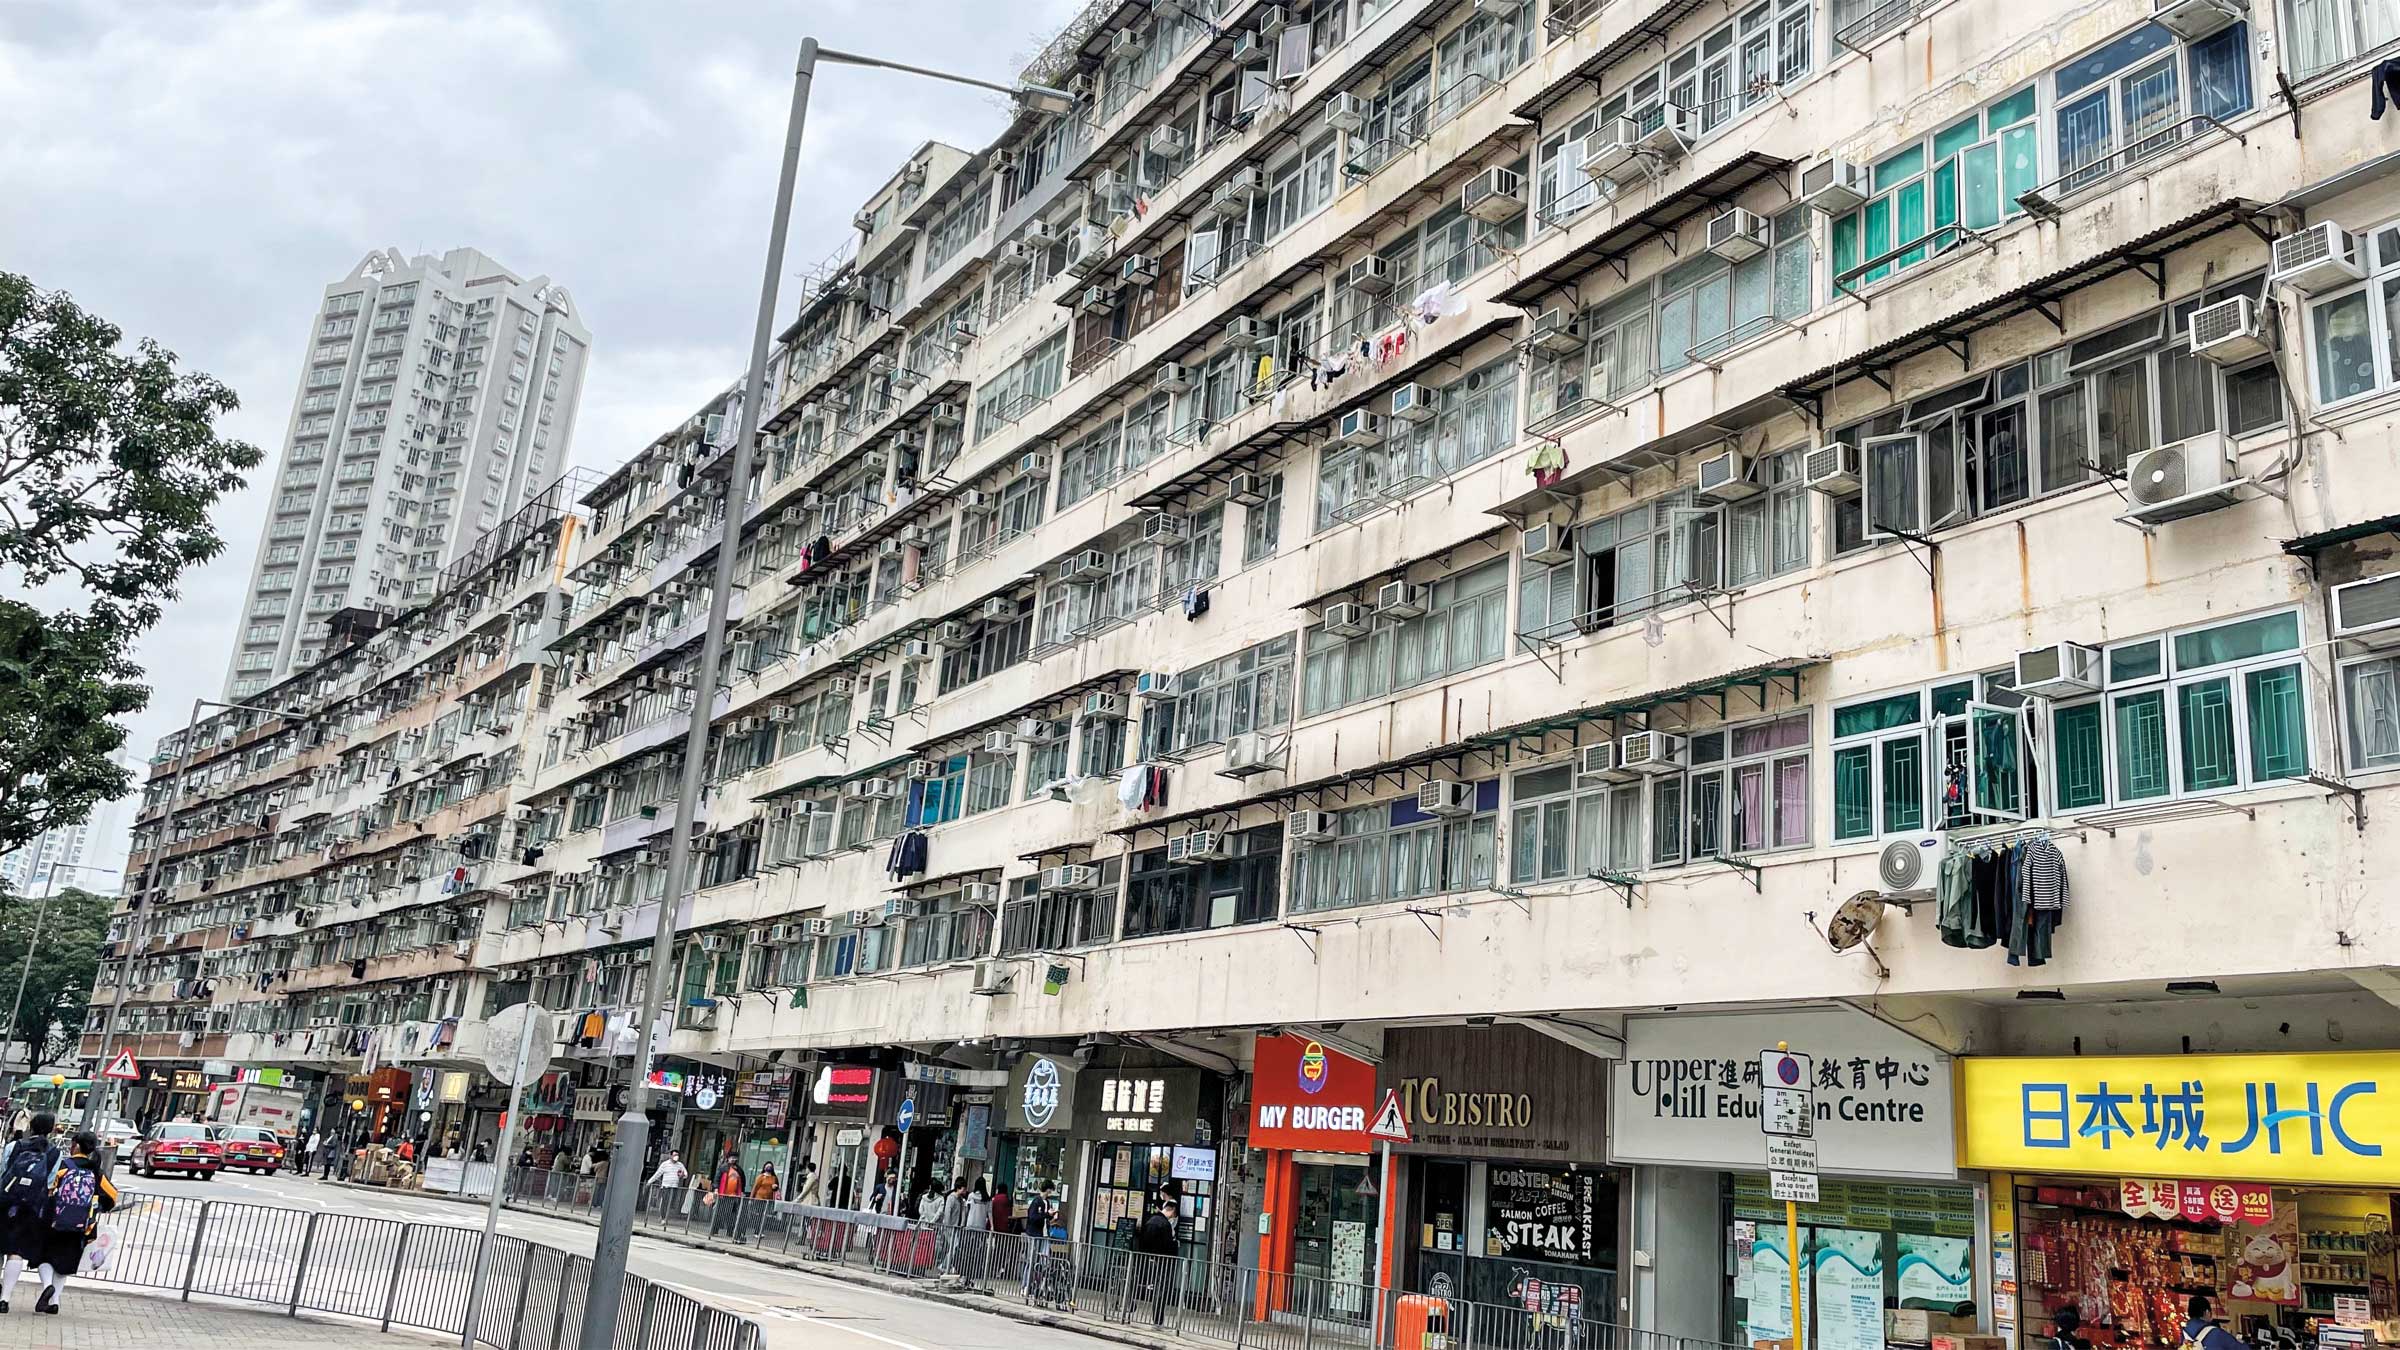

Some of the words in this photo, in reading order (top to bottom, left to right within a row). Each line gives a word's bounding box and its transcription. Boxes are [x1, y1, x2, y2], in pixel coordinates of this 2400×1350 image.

[1630, 1058, 1716, 1107] Upper
[1400, 1077, 1439, 1125] TC
[1443, 1093, 1532, 1128] BISTRO
[1774, 1098, 1790, 1107] 上午
[1839, 1096, 1924, 1122] Centre
[1260, 1105, 1287, 1128] MY
[1292, 1105, 1365, 1132] BURGER
[2022, 1080, 2210, 1151] 日本城
[2221, 1082, 2382, 1156] JHC
[1427, 1135, 1451, 1145] STEAK
[1457, 1136, 1473, 1146] ALL
[1474, 1136, 1488, 1147] DAY
[1490, 1137, 1536, 1149] BREAKFAST
[1543, 1140, 1569, 1150] SALAD
[1783, 1140, 1801, 1149] Except
[1769, 1146, 1791, 1155] General
[1793, 1149, 1815, 1158] Holidays
[1493, 1169, 1550, 1188] LOBSTER
[1551, 1180, 1570, 1192] PRIME
[2122, 1180, 2176, 1210] 全場
[2214, 1188, 2235, 1211] 送
[2242, 1192, 2268, 1206] $20
[1500, 1209, 1533, 1221] SALMON
[1535, 1202, 1567, 1218] COFFEE
[1582, 1176, 1593, 1260] BREAKFAST
[1436, 1218, 1454, 1229] OPEN
[1506, 1220, 1576, 1251] STEAK
[1544, 1249, 1579, 1260] TOMAHAWK
